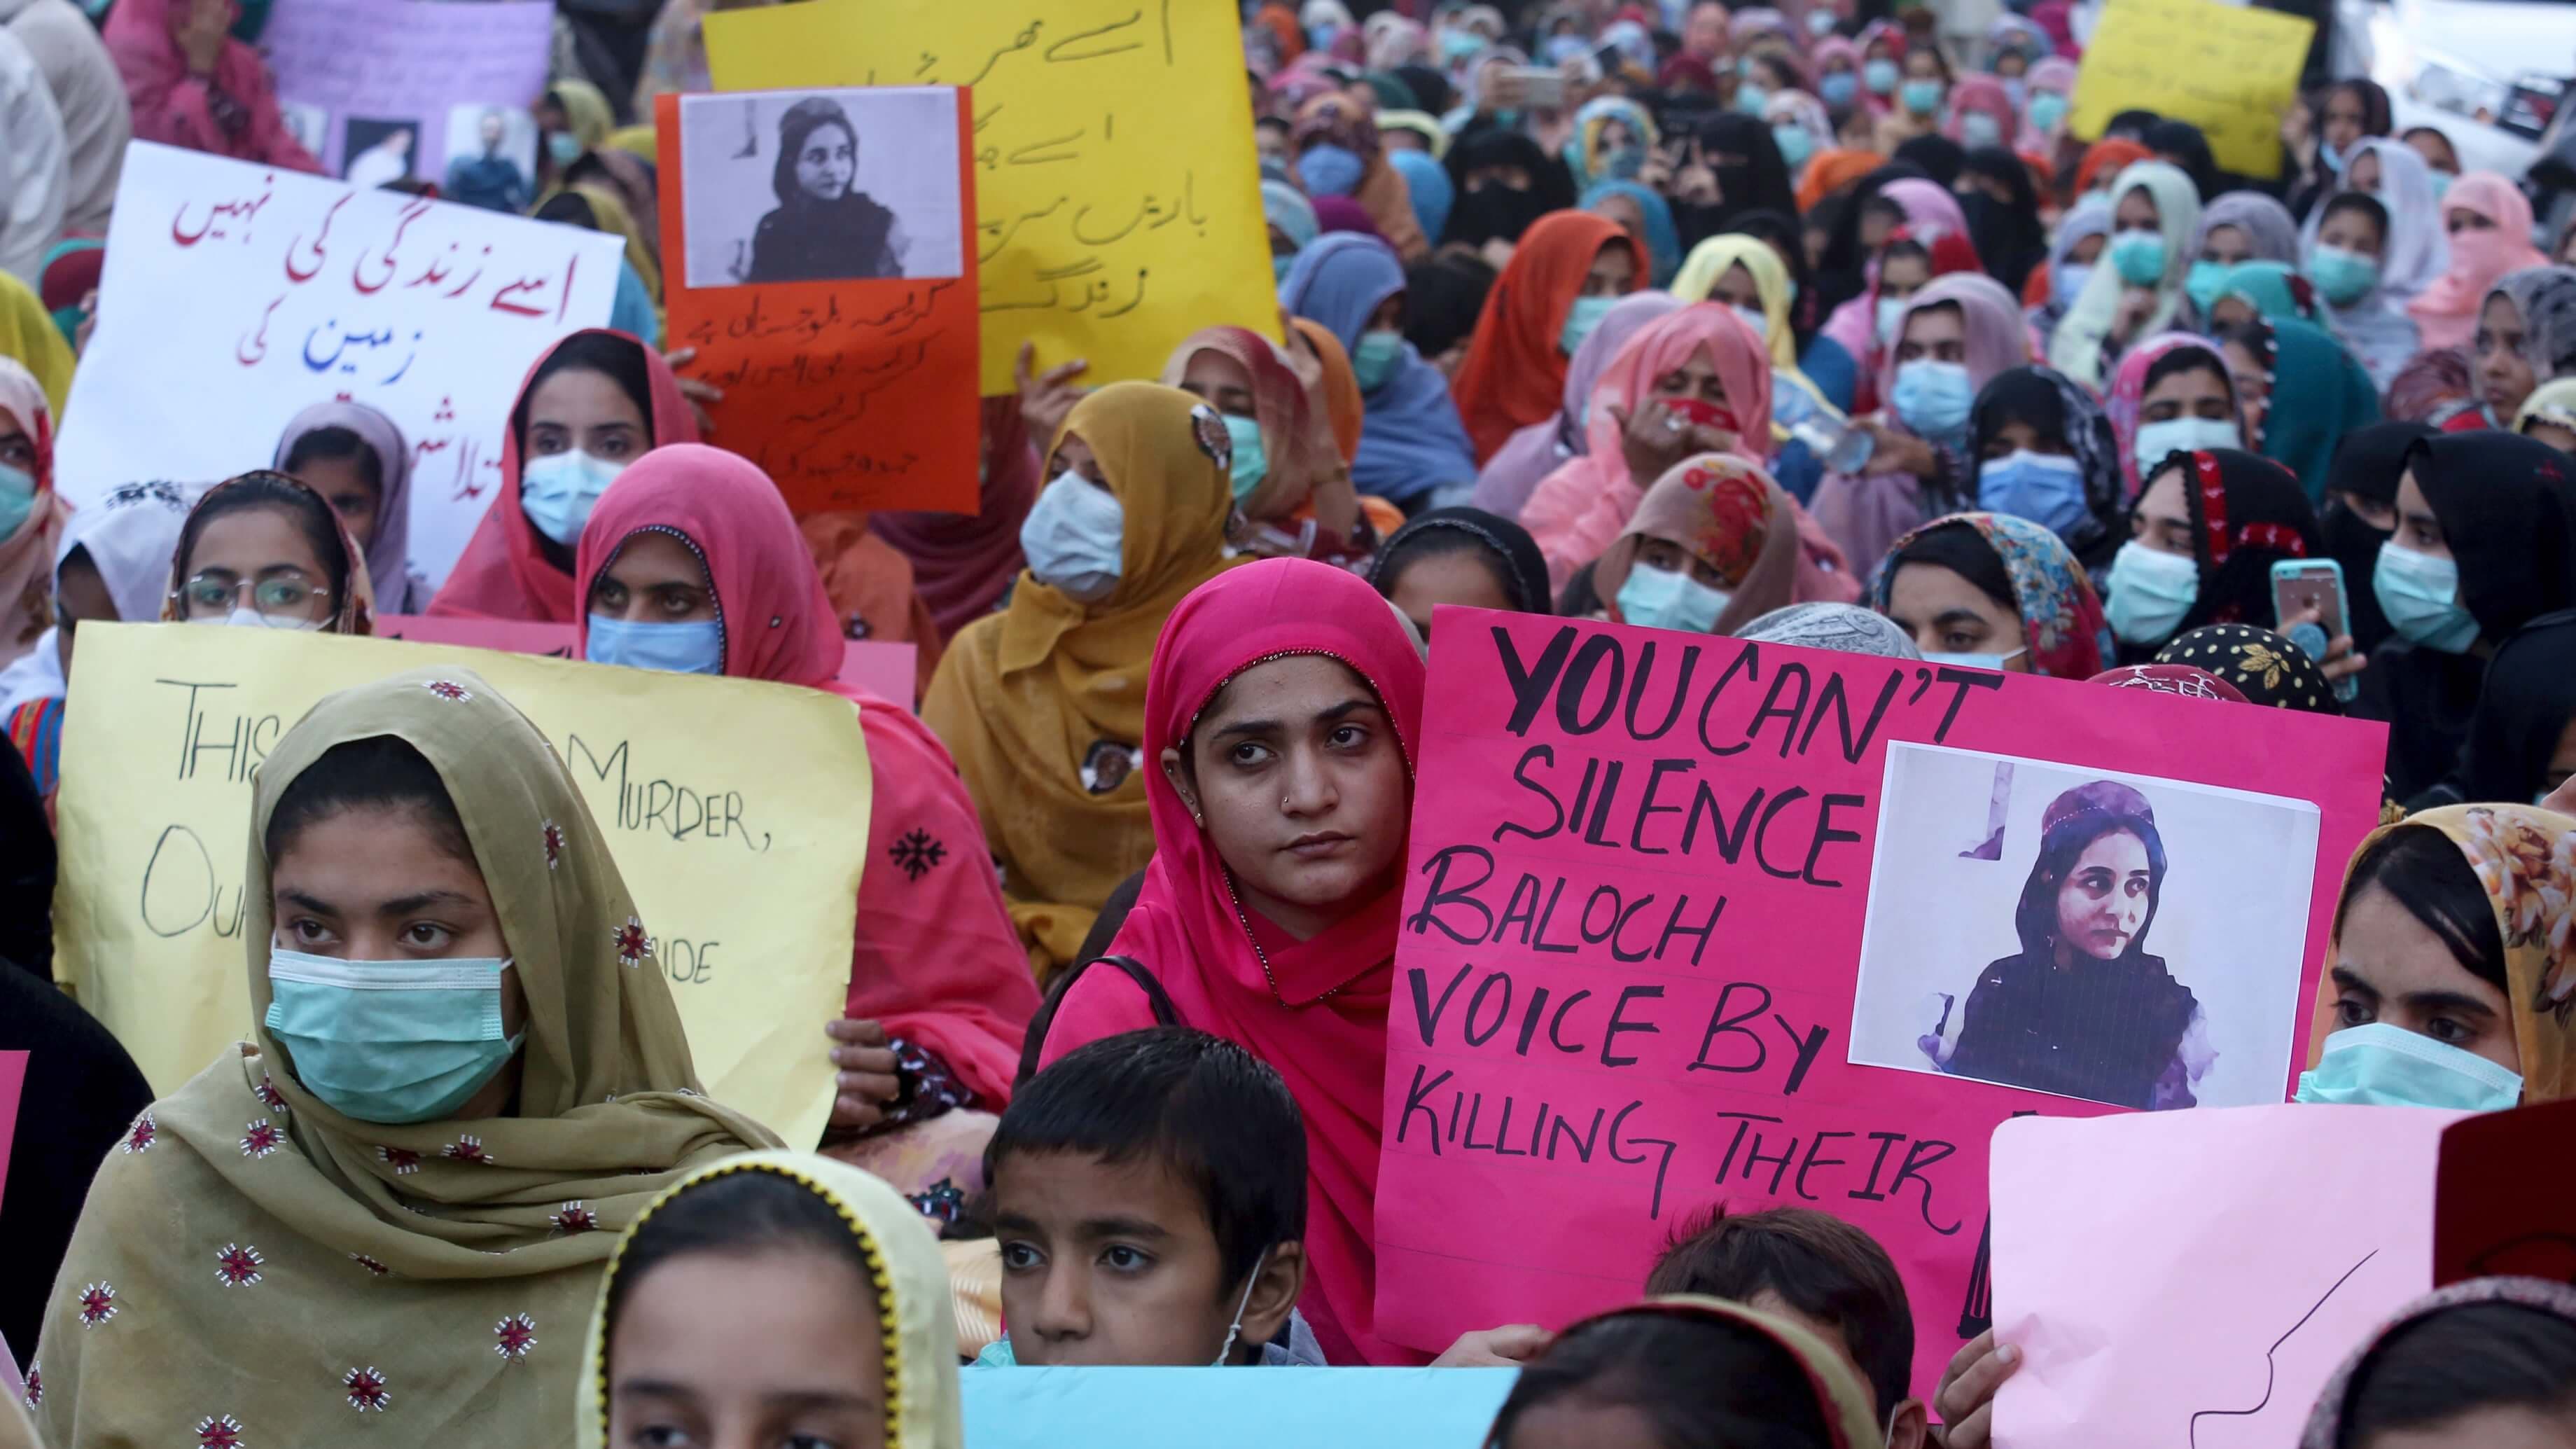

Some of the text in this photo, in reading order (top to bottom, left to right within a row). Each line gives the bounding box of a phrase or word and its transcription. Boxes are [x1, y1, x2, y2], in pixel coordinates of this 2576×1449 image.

[170, 173, 275, 248] نہیں
[284, 192, 356, 284] کی
[352, 197, 494, 300] زندگی
[234, 294, 424, 387] زمین کی
[1491, 744, 1866, 889] SILENCE
[1406, 844, 1728, 968] BALOCH
[1407, 962, 1830, 1097] VOICE BY
[1396, 1064, 1678, 1221] KILLING
[1715, 1110, 1962, 1235] THEIR
